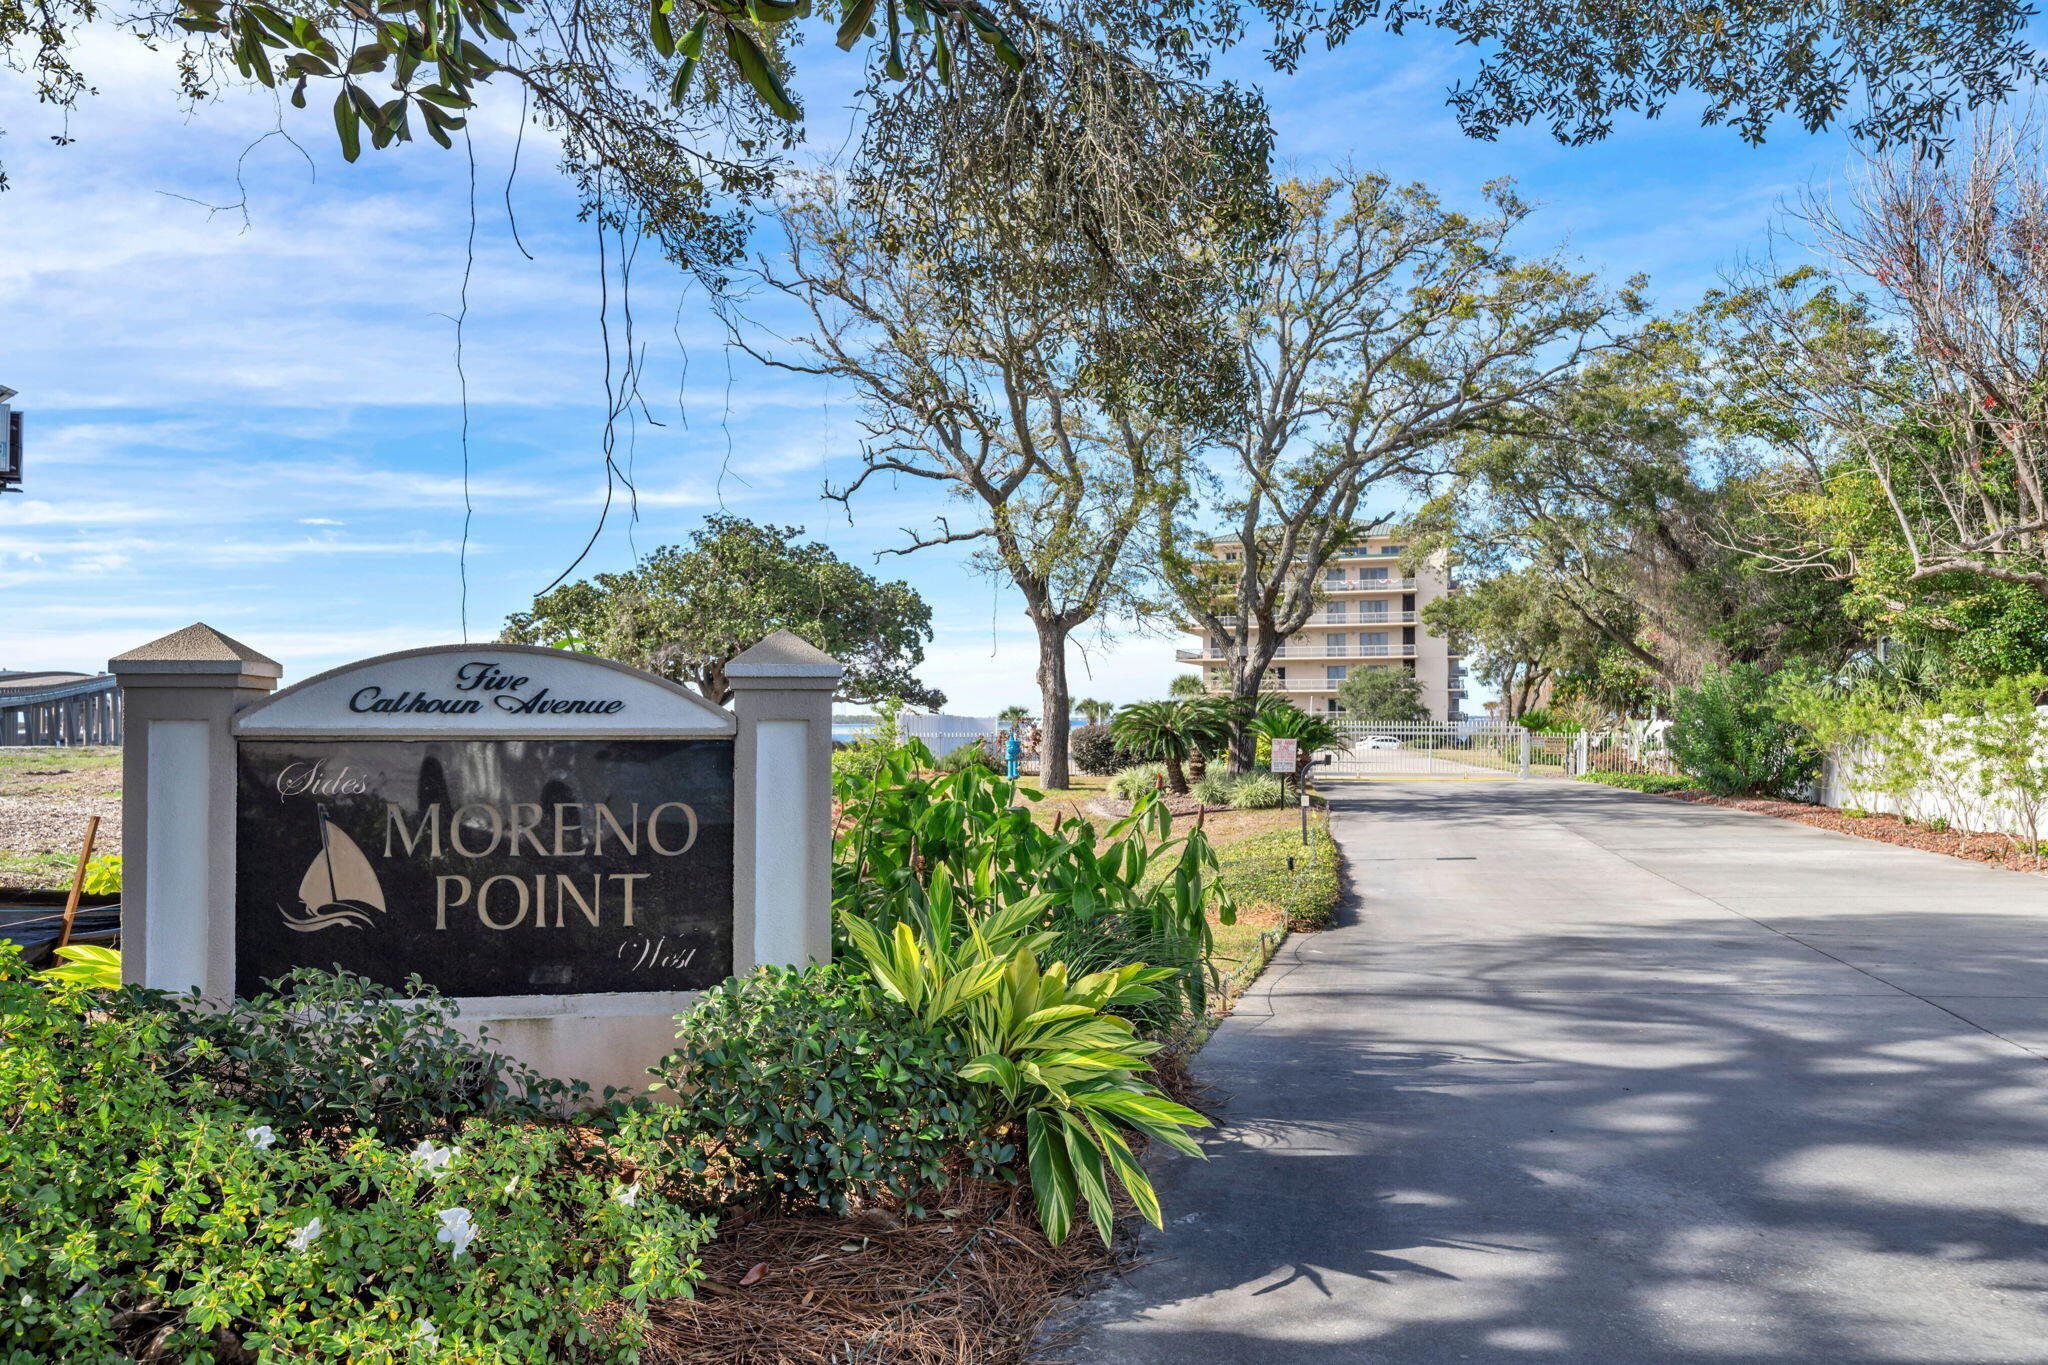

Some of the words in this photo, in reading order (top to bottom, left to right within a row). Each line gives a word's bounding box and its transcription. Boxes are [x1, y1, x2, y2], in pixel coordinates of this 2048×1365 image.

[456, 661, 529, 692] Five
[349, 686, 483, 714] Calhoun
[494, 688, 626, 714] Avenue
[276, 758, 368, 803] Sides
[383, 801, 699, 858] MORENO
[435, 872, 652, 930] POINT
